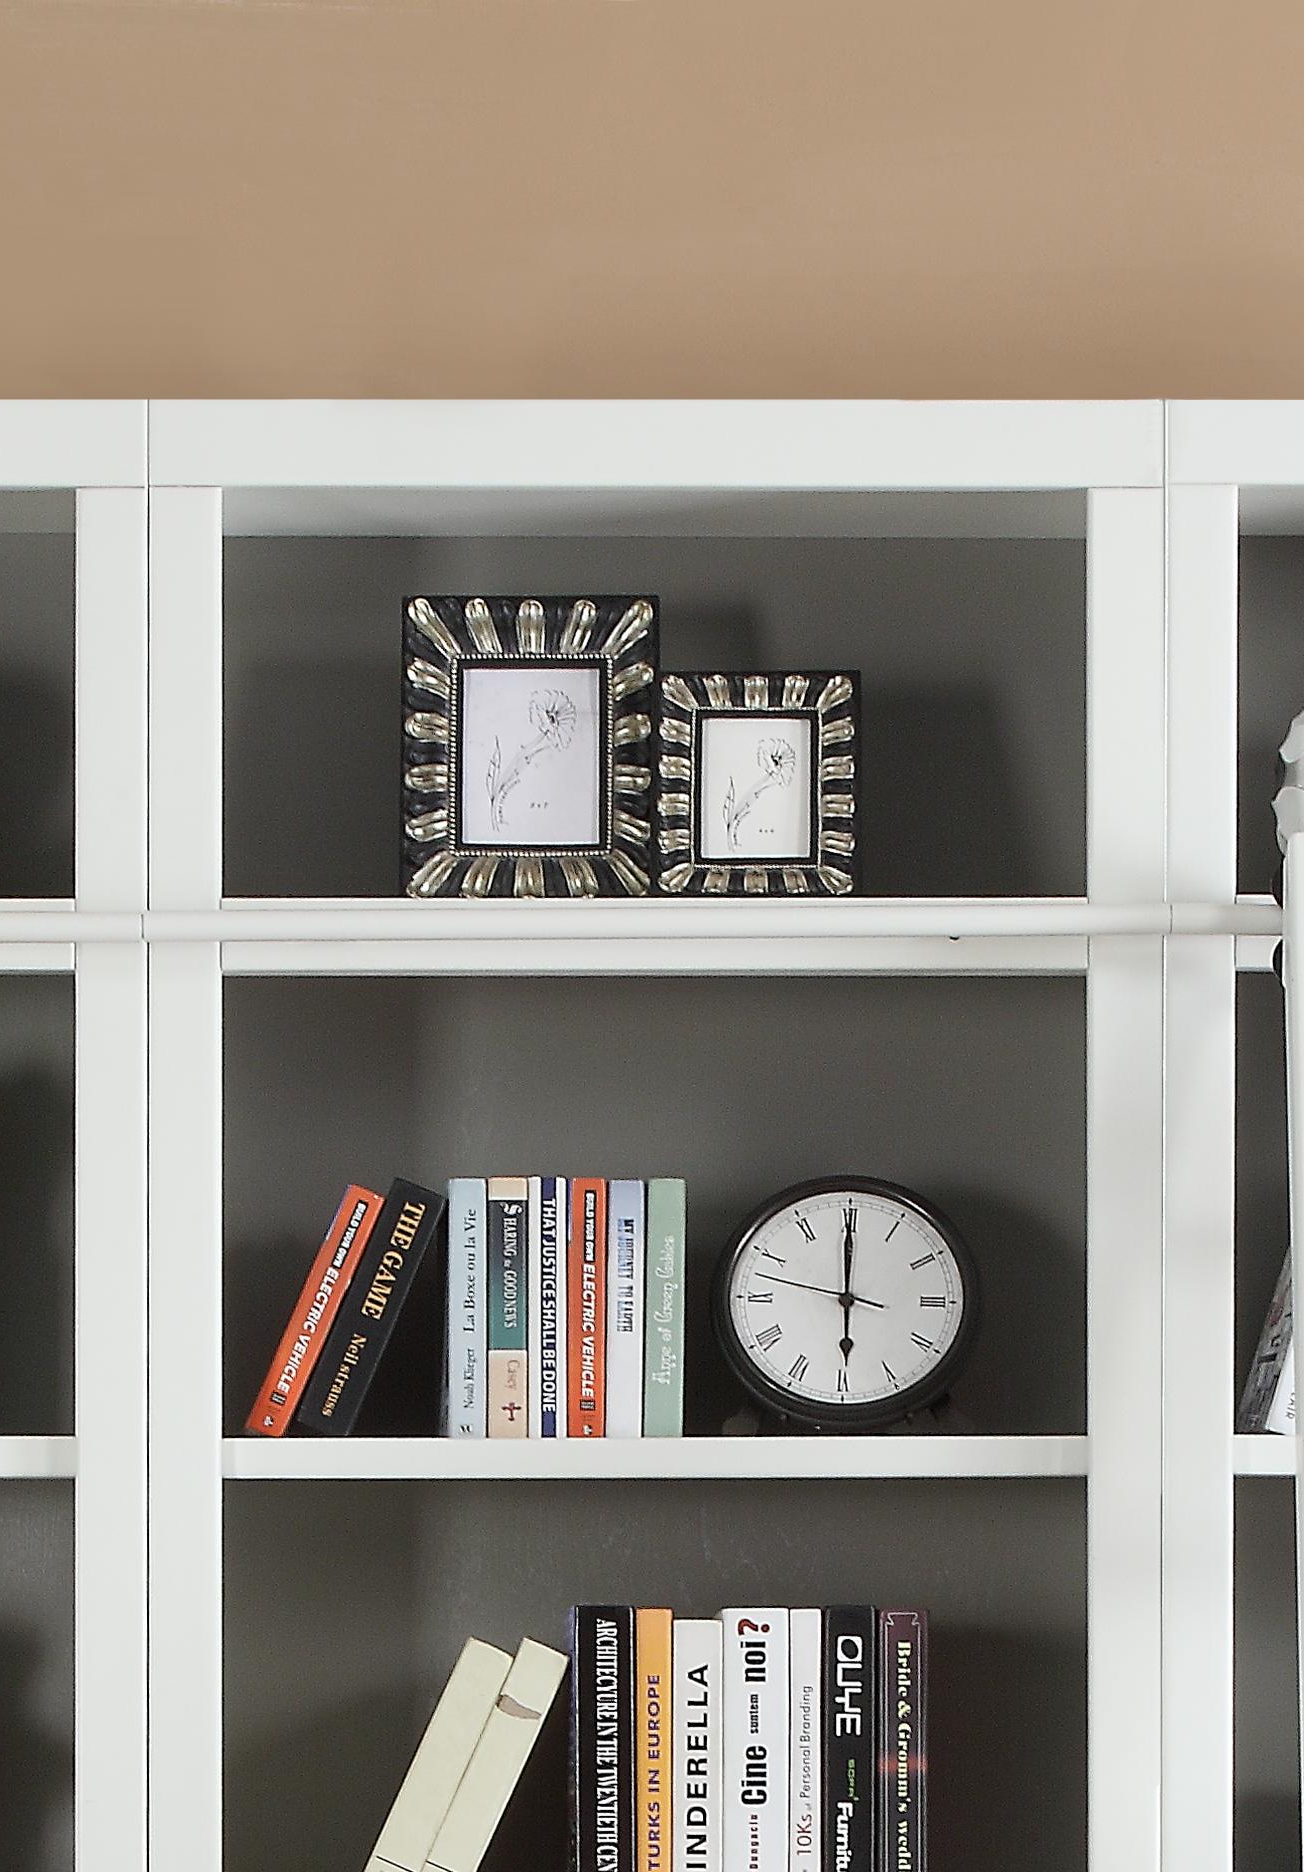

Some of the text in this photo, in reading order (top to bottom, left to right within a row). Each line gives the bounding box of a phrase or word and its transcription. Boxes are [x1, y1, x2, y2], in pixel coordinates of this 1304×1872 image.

[390, 1202, 426, 1250] THE
[361, 1250, 404, 1320] GAME
[463, 1208, 477, 1332] La Boxe ou la Vie
[582, 1263, 596, 1333] ELECTRIC
[303, 1267, 340, 1334] ELECTRIC
[542, 1198, 557, 1412] THAT JUSTICE SHALL BE DONE
[277, 1334, 311, 1394] VEHICLE
[343, 1333, 367, 1366] Neil
[581, 1336, 595, 1397] VEHICLE
[897, 1641, 912, 1697] Bride
[596, 1722, 618, 1737] IN
[897, 1700, 912, 1719] &
[596, 1737, 618, 1765] THE
[647, 1674, 661, 1872] TURKS IN EUROPE
[741, 1745, 767, 1805] Cine
[797, 1685, 813, 1856] 10Ks Personal Branding
